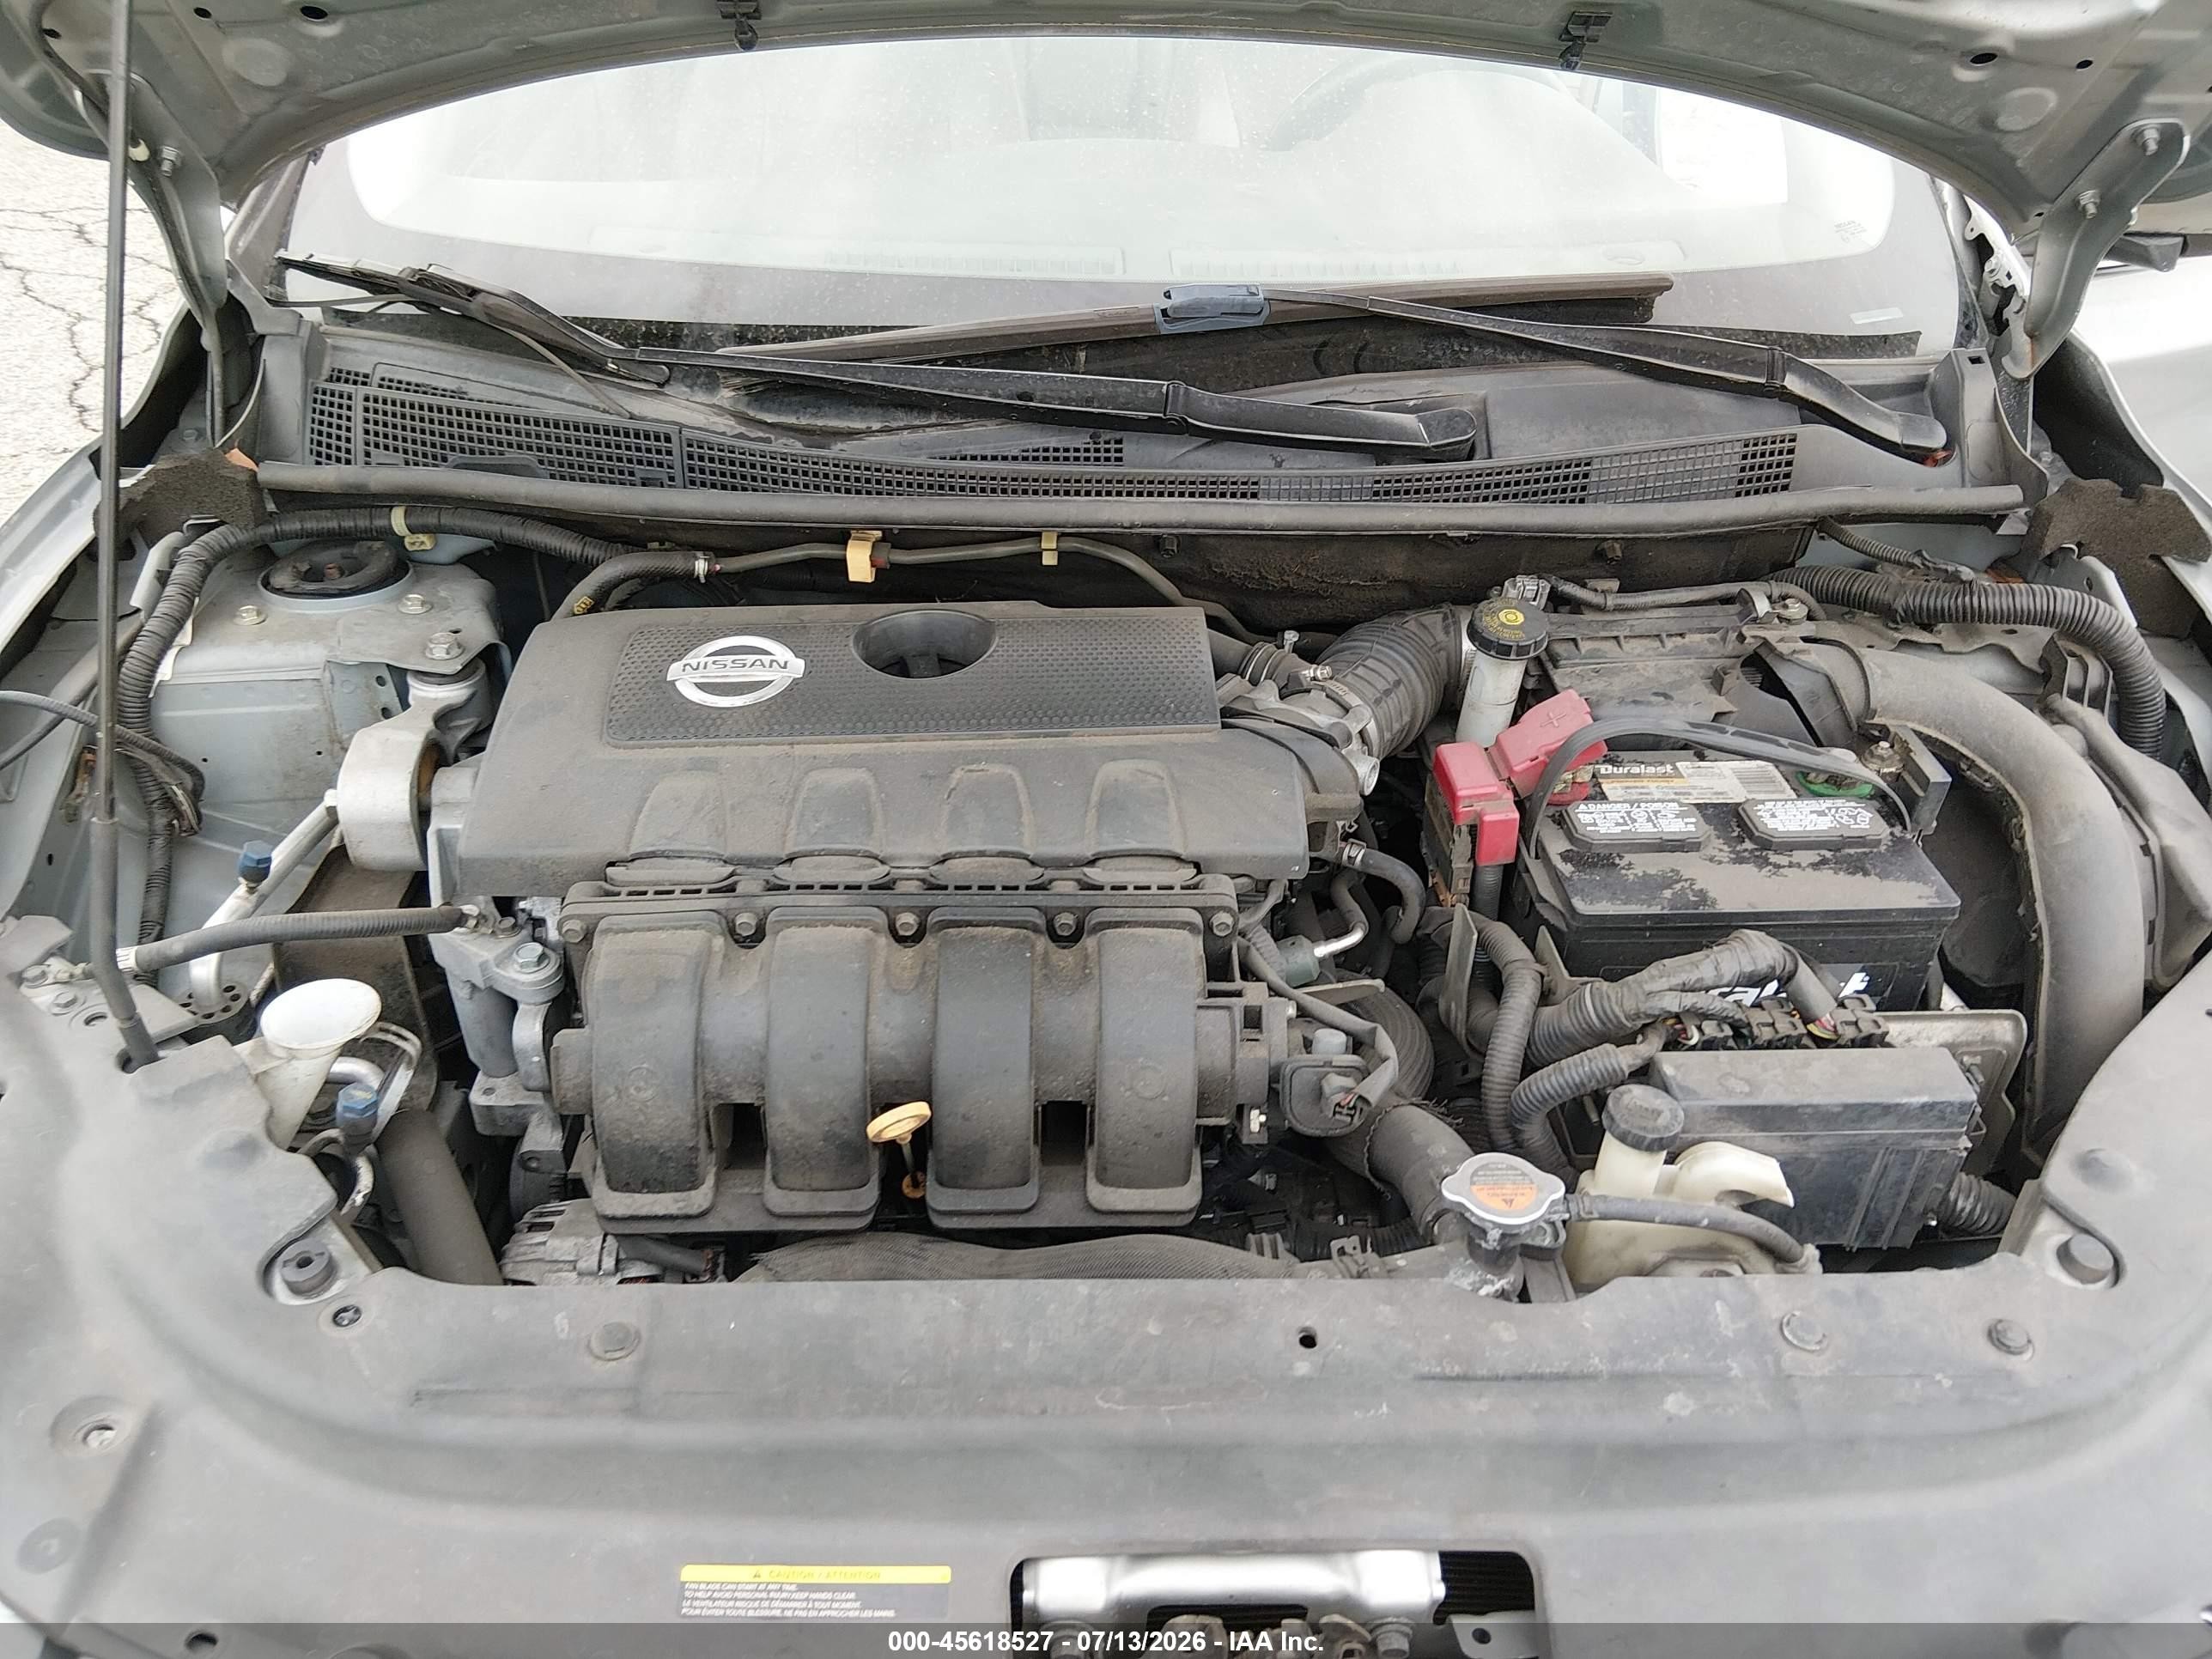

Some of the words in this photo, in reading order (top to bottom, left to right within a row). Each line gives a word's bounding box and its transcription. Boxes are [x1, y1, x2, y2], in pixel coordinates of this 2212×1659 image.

[682, 659, 788, 672] NISSAN
[1595, 763, 1674, 775] Duralast
[769, 1570, 814, 1580] CAUTION
[826, 1570, 881, 1580] ATTENTION
[685, 1583, 699, 1591] FAN
